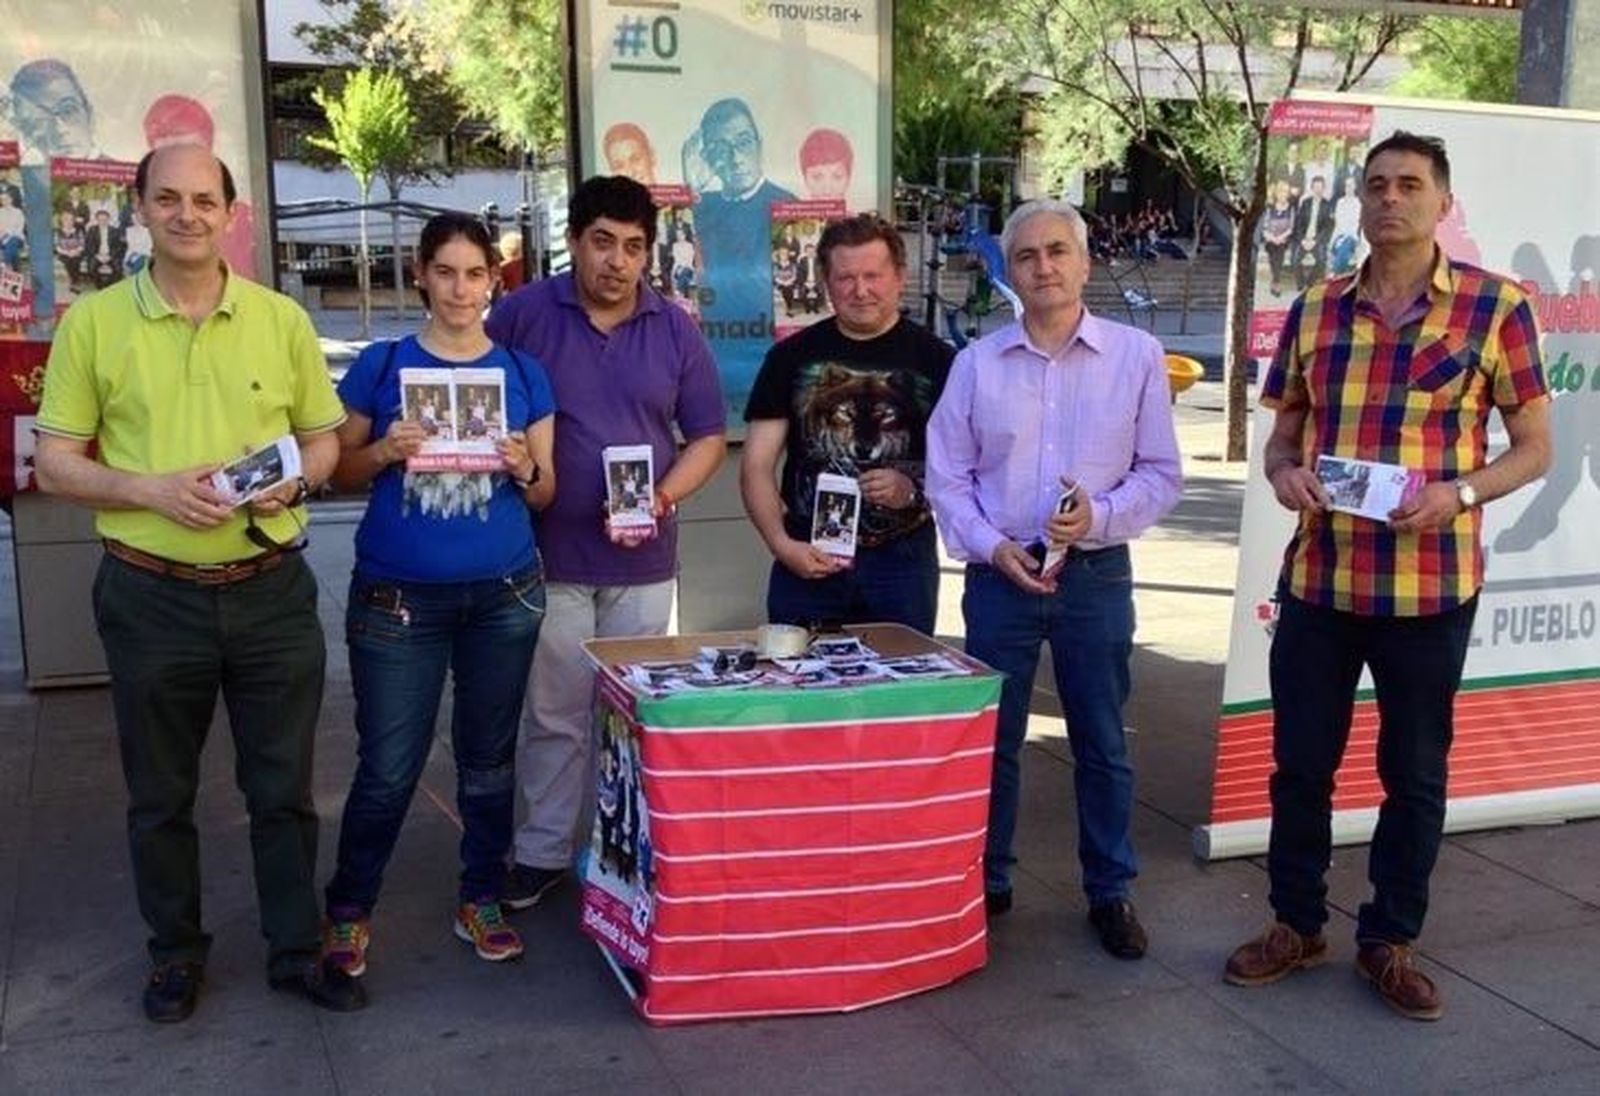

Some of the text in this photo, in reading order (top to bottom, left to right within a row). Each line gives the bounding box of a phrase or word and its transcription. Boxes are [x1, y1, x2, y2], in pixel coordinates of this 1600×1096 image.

[768, 3, 862, 22] movistar+
[613, 15, 678, 59] #0
[1492, 600, 1595, 646] PUEBLO
